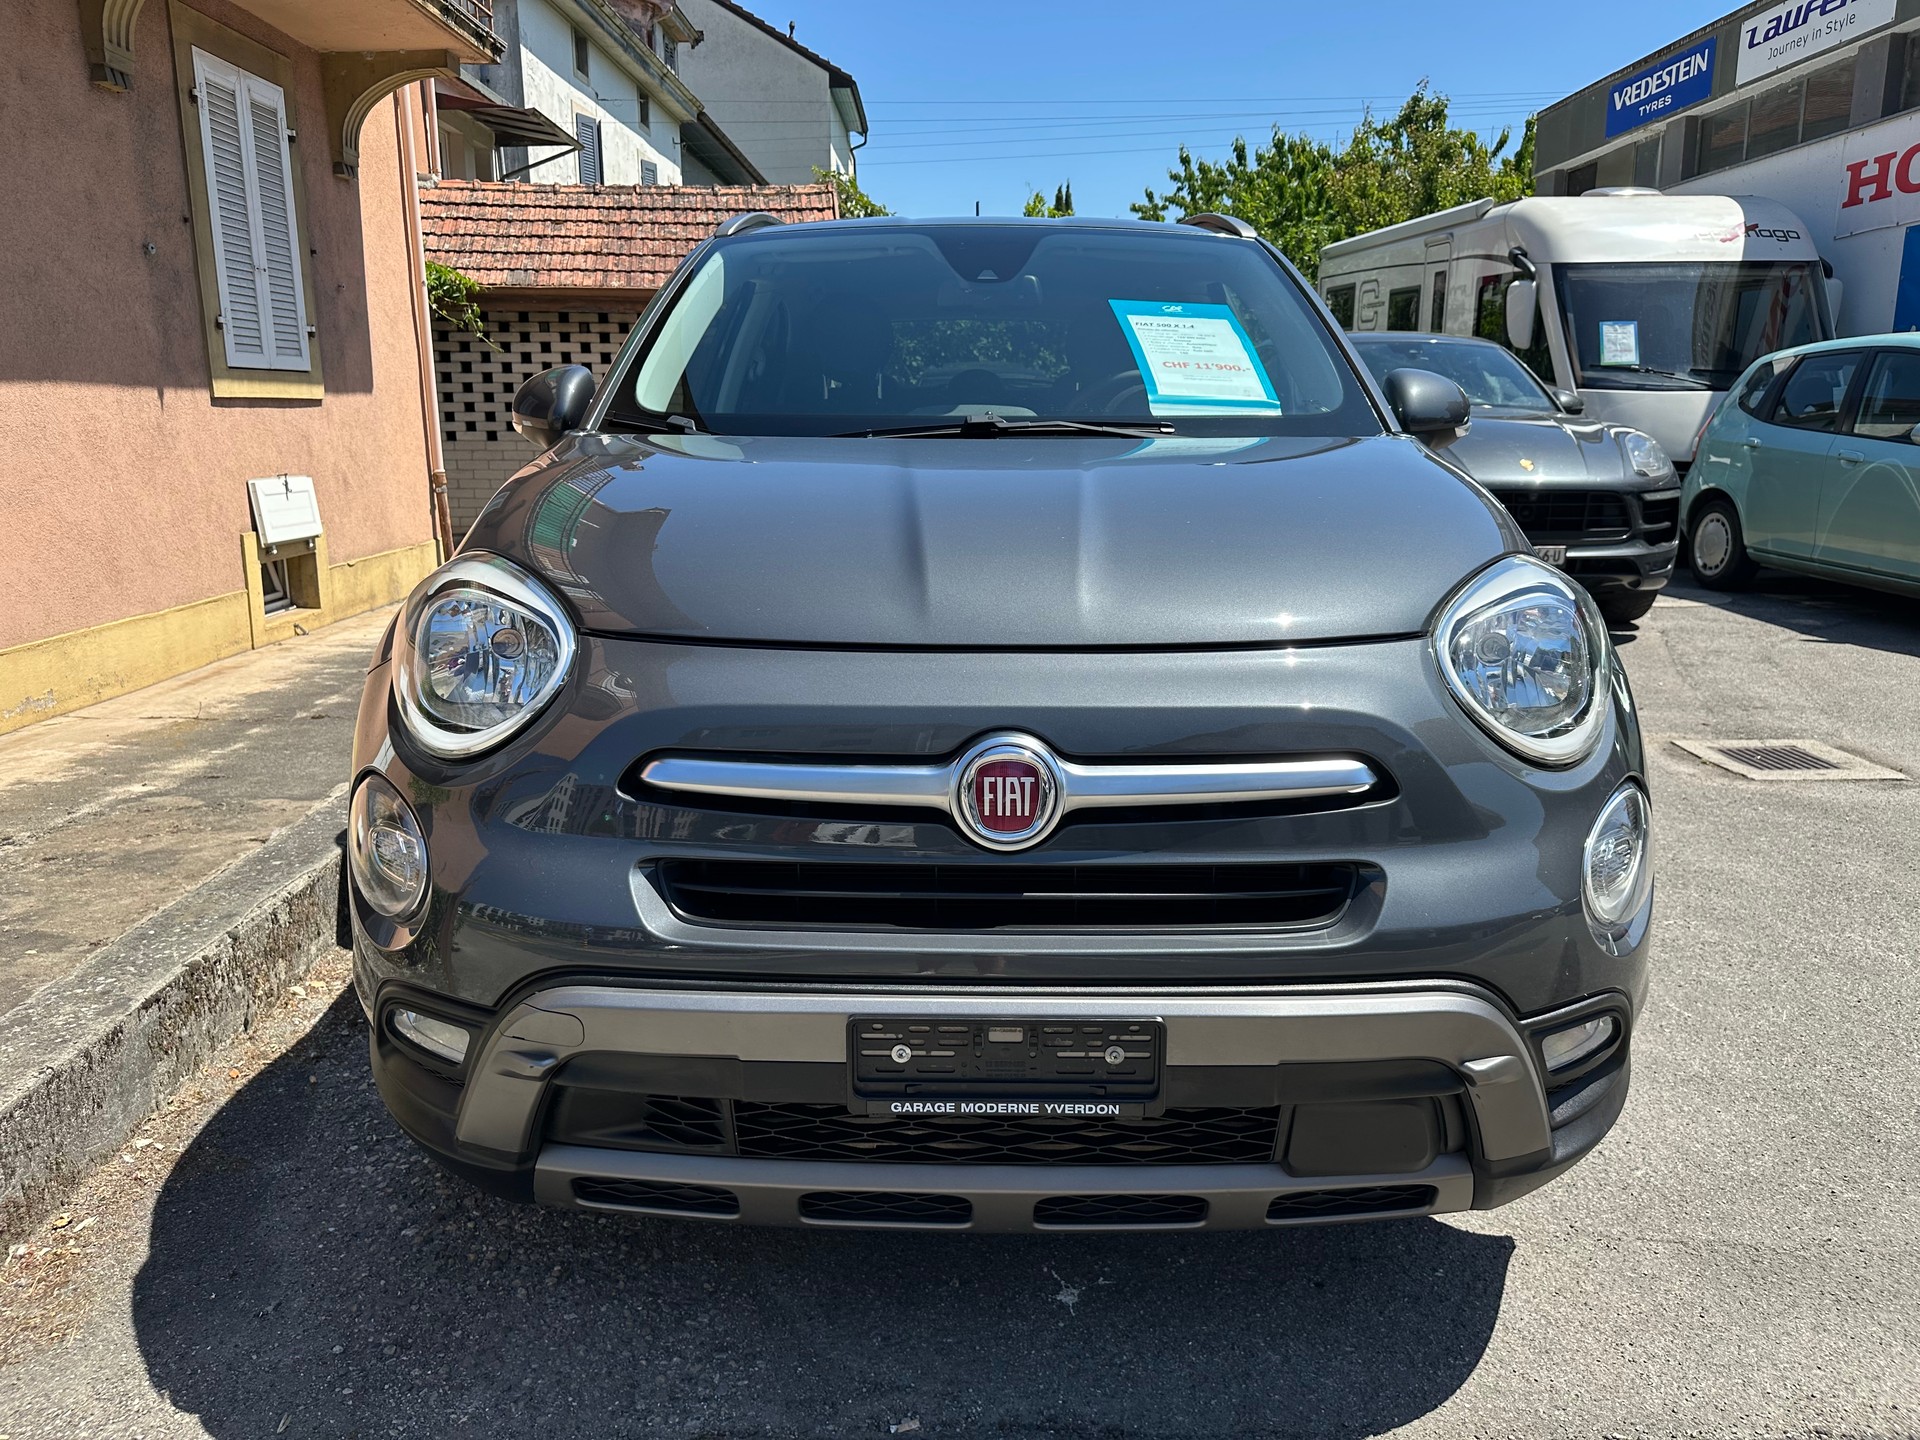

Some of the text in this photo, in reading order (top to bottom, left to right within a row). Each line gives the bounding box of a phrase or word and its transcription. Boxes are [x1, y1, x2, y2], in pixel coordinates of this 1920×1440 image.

[1768, 12, 1856, 60] Journey in Style
[1613, 48, 1709, 111] VREDESTEIN
[1638, 95, 1672, 117] TYRES
[1162, 360, 1252, 373] CHF 11'900.-
[982, 776, 1036, 817] FIAT
[890, 1102, 1120, 1116] GARAGE MODERNE YVERDON
